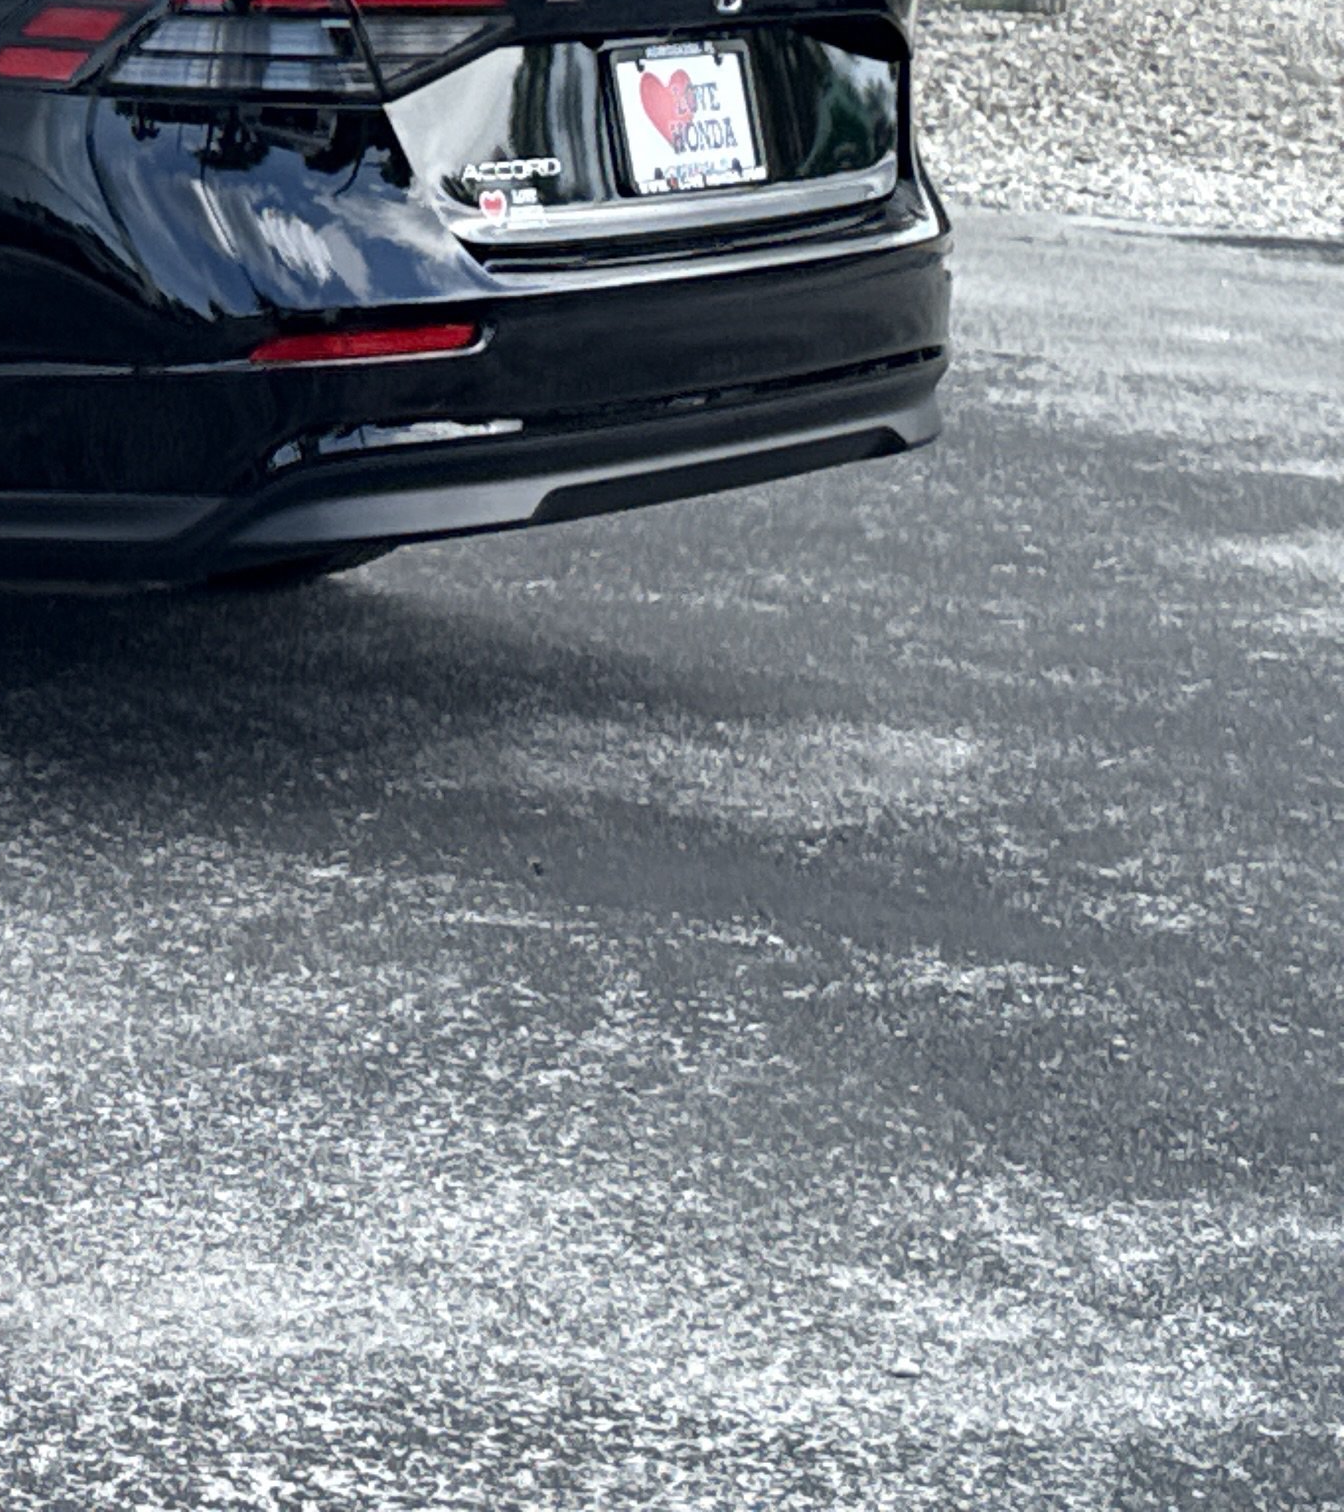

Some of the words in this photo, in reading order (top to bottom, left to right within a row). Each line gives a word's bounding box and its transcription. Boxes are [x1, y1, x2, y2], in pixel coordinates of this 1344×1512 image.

[672, 82, 721, 115] LOVE
[672, 117, 738, 155] HONDA
[461, 157, 561, 182] ACCORD
